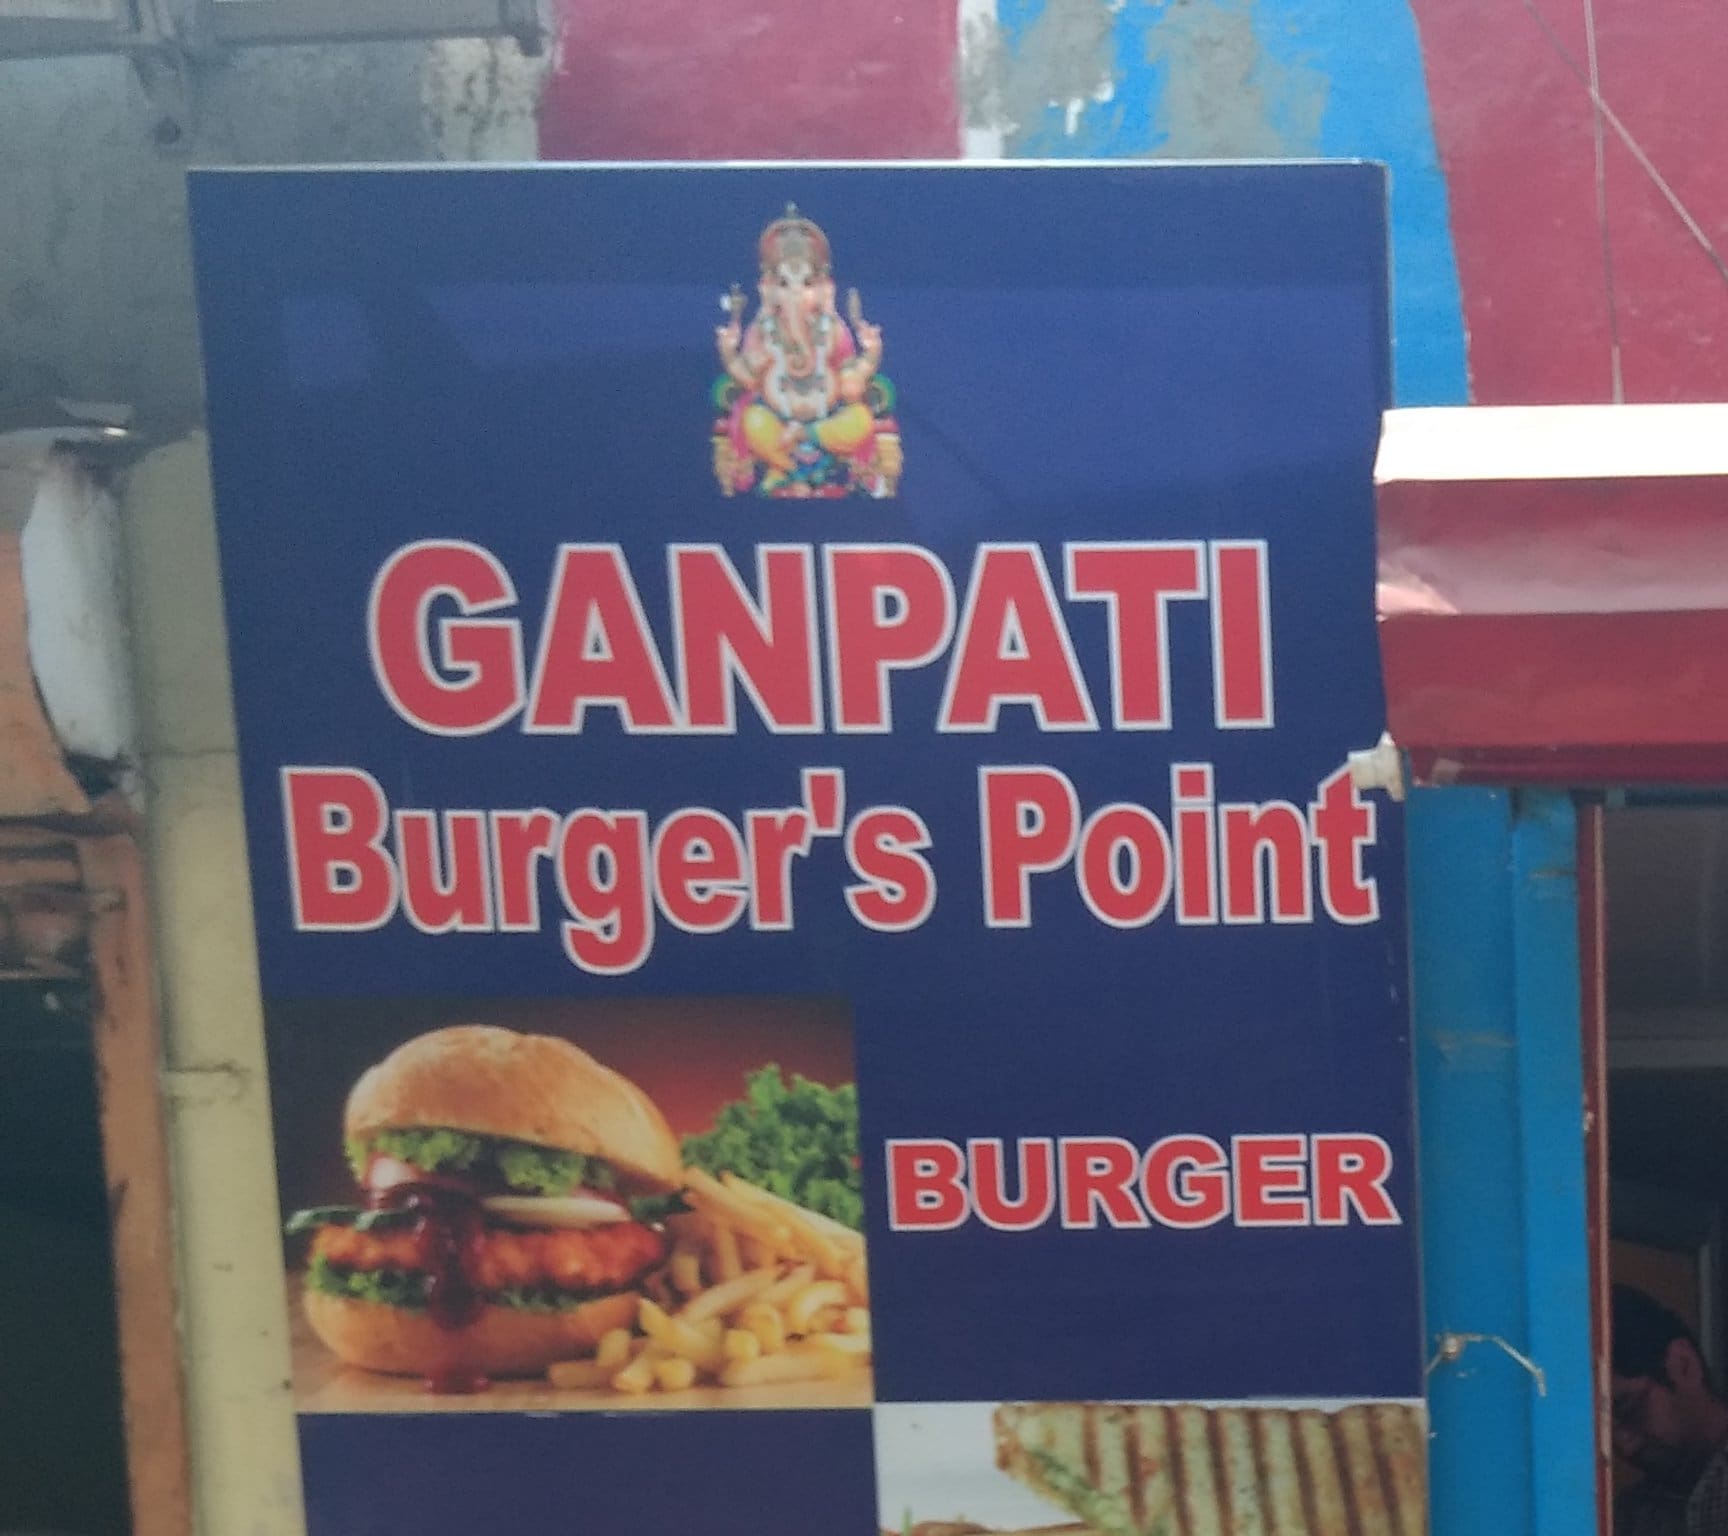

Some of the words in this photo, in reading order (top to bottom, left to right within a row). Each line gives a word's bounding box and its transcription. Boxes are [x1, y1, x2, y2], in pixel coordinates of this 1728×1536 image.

[366, 538, 1275, 736] GANPATI
[279, 767, 935, 976] Burger's
[979, 765, 1380, 927] Point
[886, 1134, 1402, 1230] BURGER
